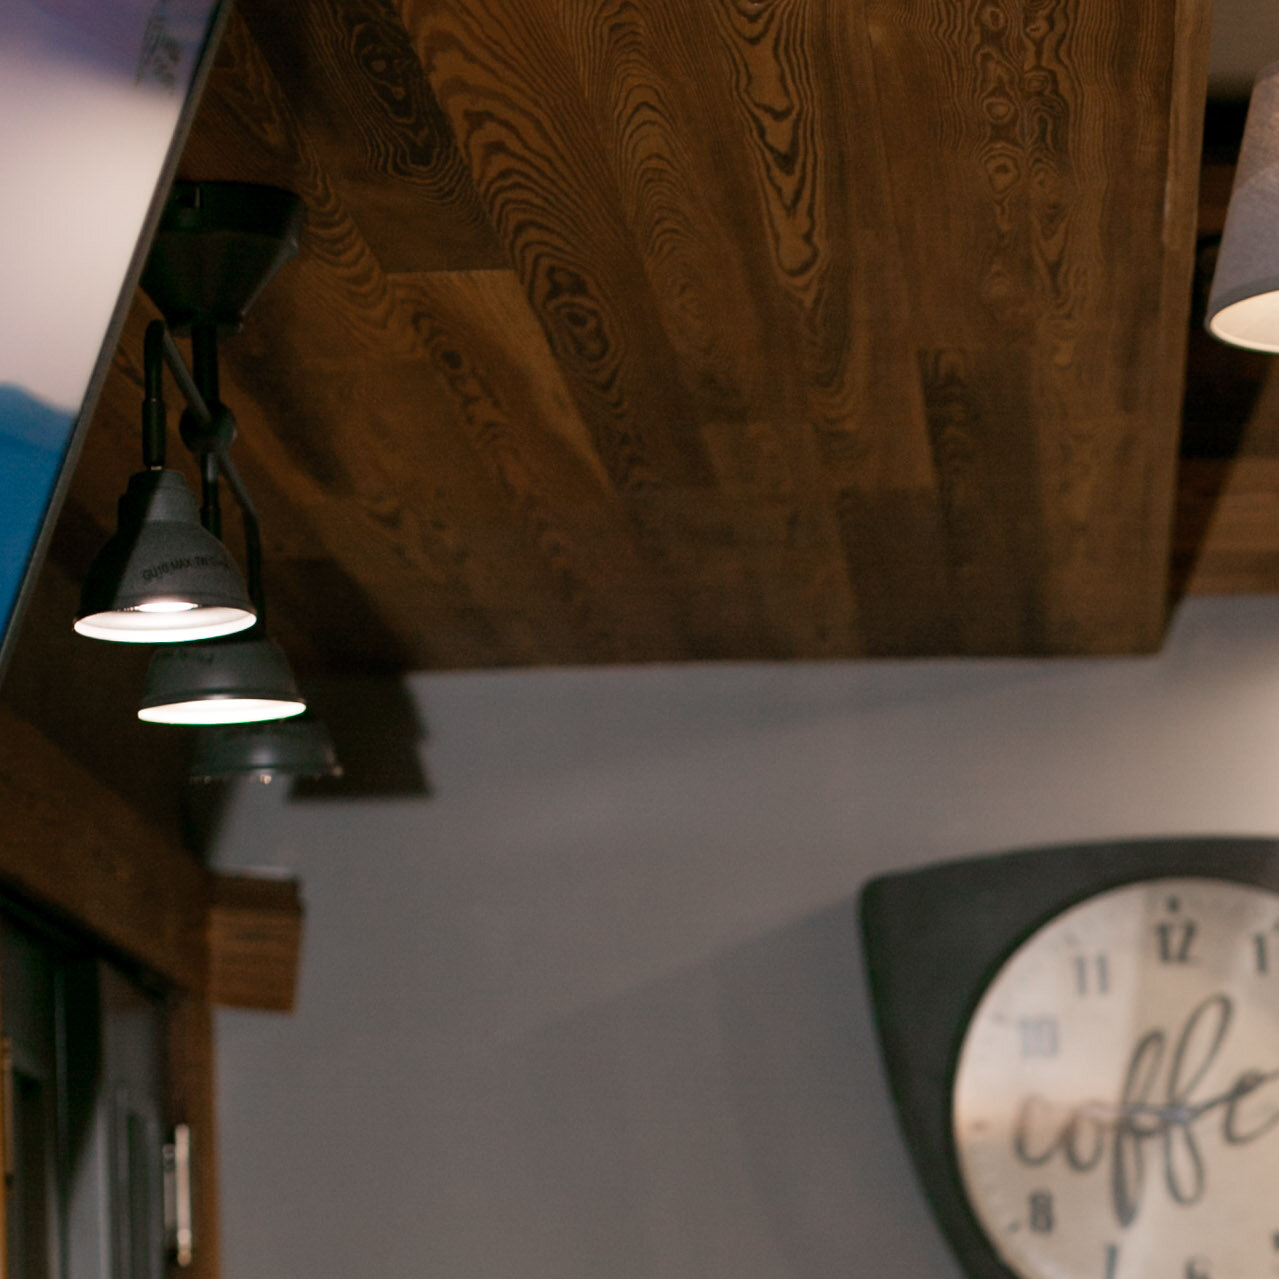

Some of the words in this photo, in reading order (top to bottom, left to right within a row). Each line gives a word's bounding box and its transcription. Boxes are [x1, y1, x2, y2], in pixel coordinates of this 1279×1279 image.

[1156, 920, 1199, 964] 12
[1072, 955, 1109, 996] 11
[1028, 1190, 1054, 1235] 8
